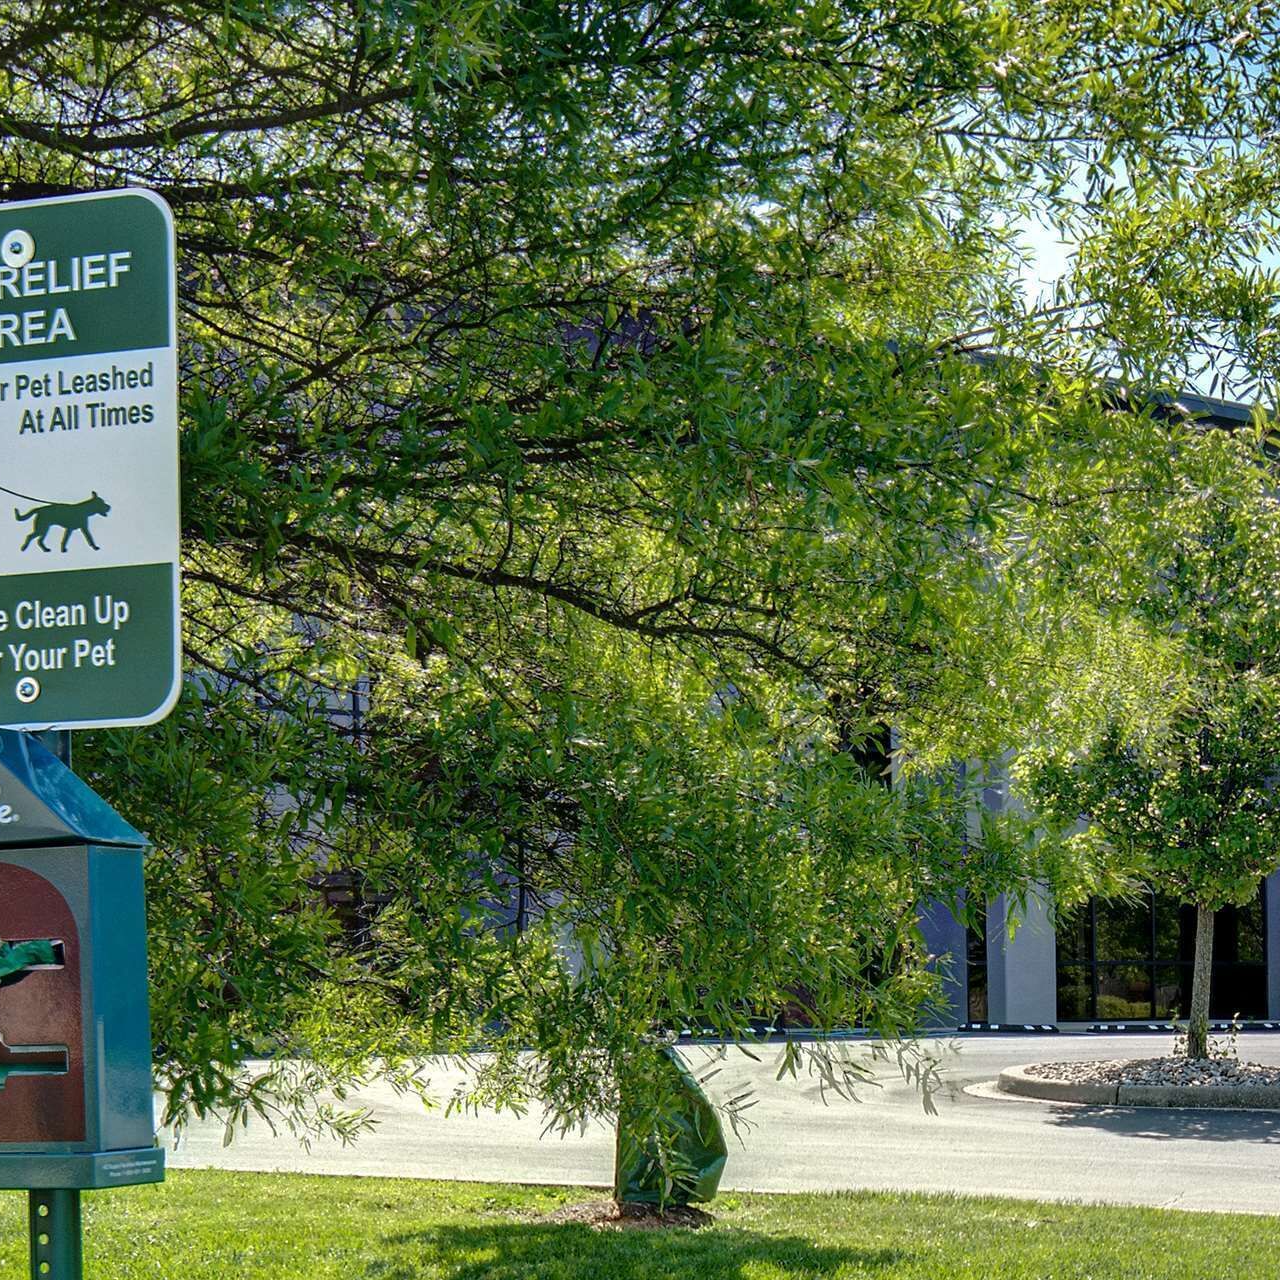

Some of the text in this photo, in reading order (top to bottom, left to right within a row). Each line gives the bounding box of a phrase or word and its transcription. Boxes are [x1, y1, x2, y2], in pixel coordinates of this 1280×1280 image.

[15, 373, 51, 400] Pet
[58, 362, 153, 396] Leashed
[19, 401, 154, 435] At All Times
[15, 600, 88, 630] Clean
[94, 594, 130, 630] Up
[8, 643, 68, 672] Your
[74, 638, 117, 668] Pet
